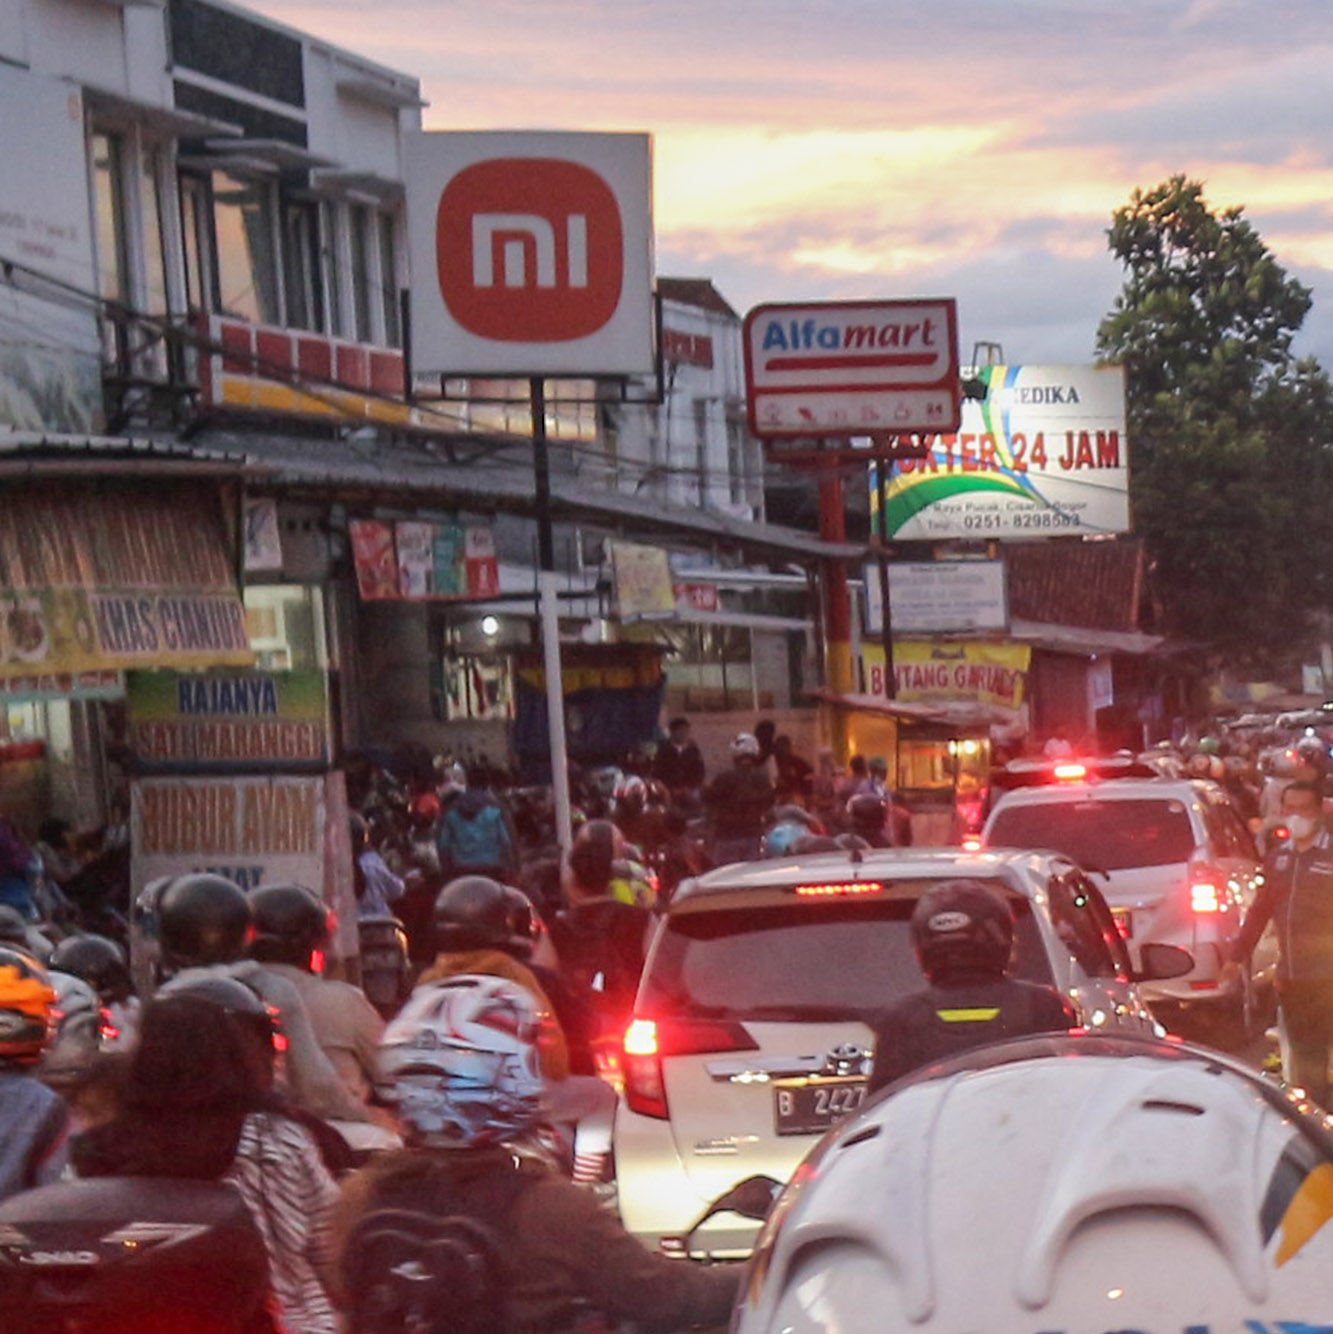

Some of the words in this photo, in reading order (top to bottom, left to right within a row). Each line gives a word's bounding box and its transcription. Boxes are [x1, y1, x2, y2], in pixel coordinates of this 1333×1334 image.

[762, 318, 938, 350] Alfamart
[1015, 386, 1080, 404] EDIKA
[1011, 430, 1048, 473] 24
[1058, 429, 1120, 471] JAM
[870, 664, 949, 696] BTANG
[778, 1090, 793, 1115] B
[814, 1086, 867, 1115] 2427
